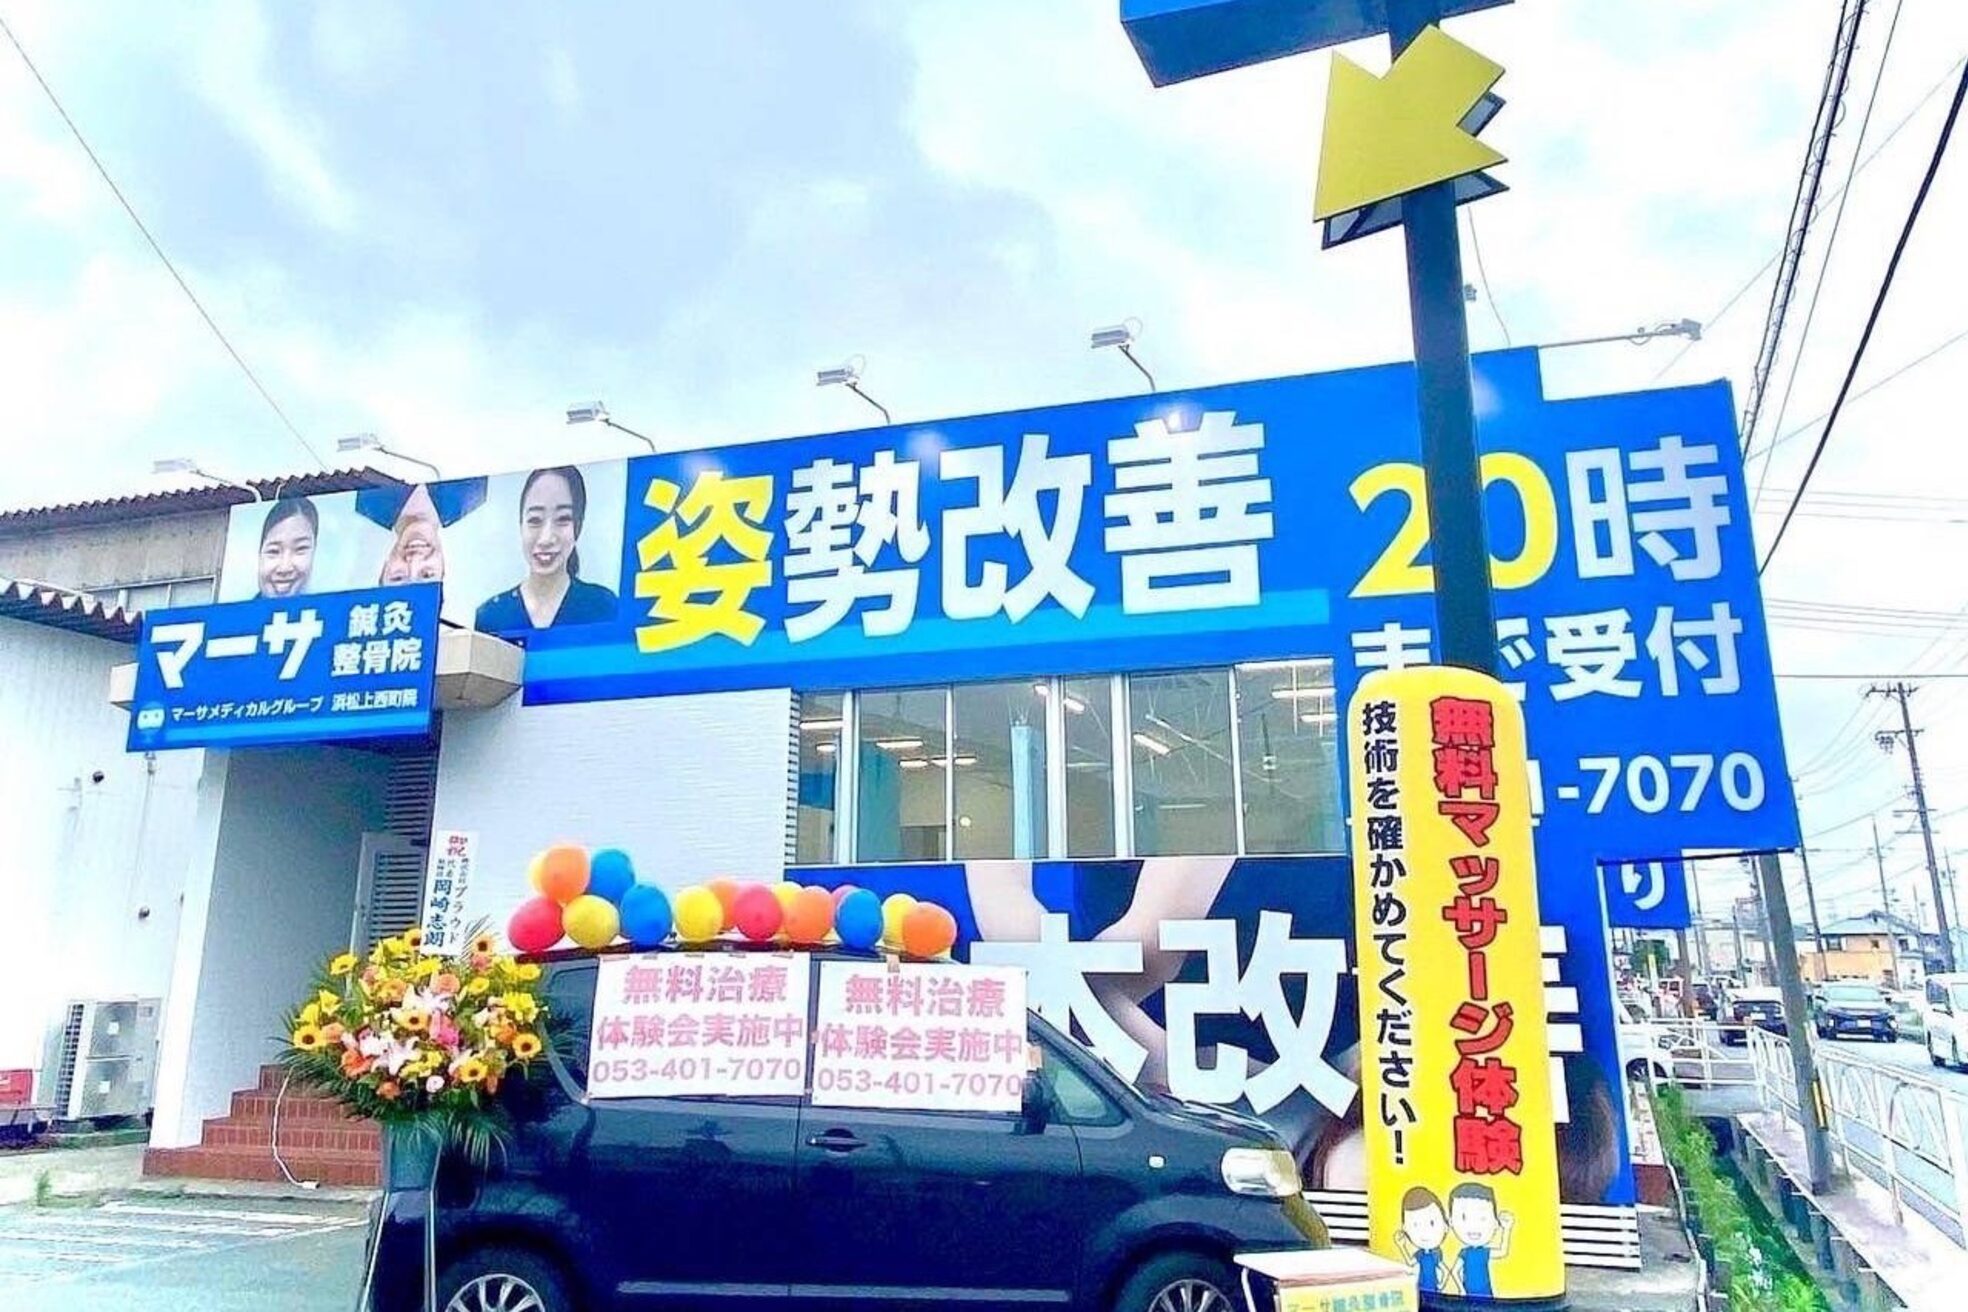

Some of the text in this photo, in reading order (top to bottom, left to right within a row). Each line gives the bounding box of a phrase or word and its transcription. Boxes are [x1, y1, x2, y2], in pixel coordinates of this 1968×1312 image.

[634, 410, 1275, 653] 姿勢改善
[1348, 435, 1731, 598] 20時
[348, 601, 413, 637] 鍼灸
[150, 609, 323, 689] マーサ
[332, 637, 423, 678] 整骨院
[171, 696, 325, 721] マーサメディカルグループ
[1362, 700, 1417, 1165] 技術を確かめてください！
[1429, 696, 1523, 1175] 無料マッサージ体験
[623, 963, 788, 1004] 無料治療
[844, 972, 1006, 1018] 無料治療
[596, 1014, 804, 1051] 体験会実施中
[819, 1025, 1024, 1065] 体験会実施中
[592, 1056, 802, 1084] 053-401-7070
[817, 1068, 1023, 1098] 053-401-7070
